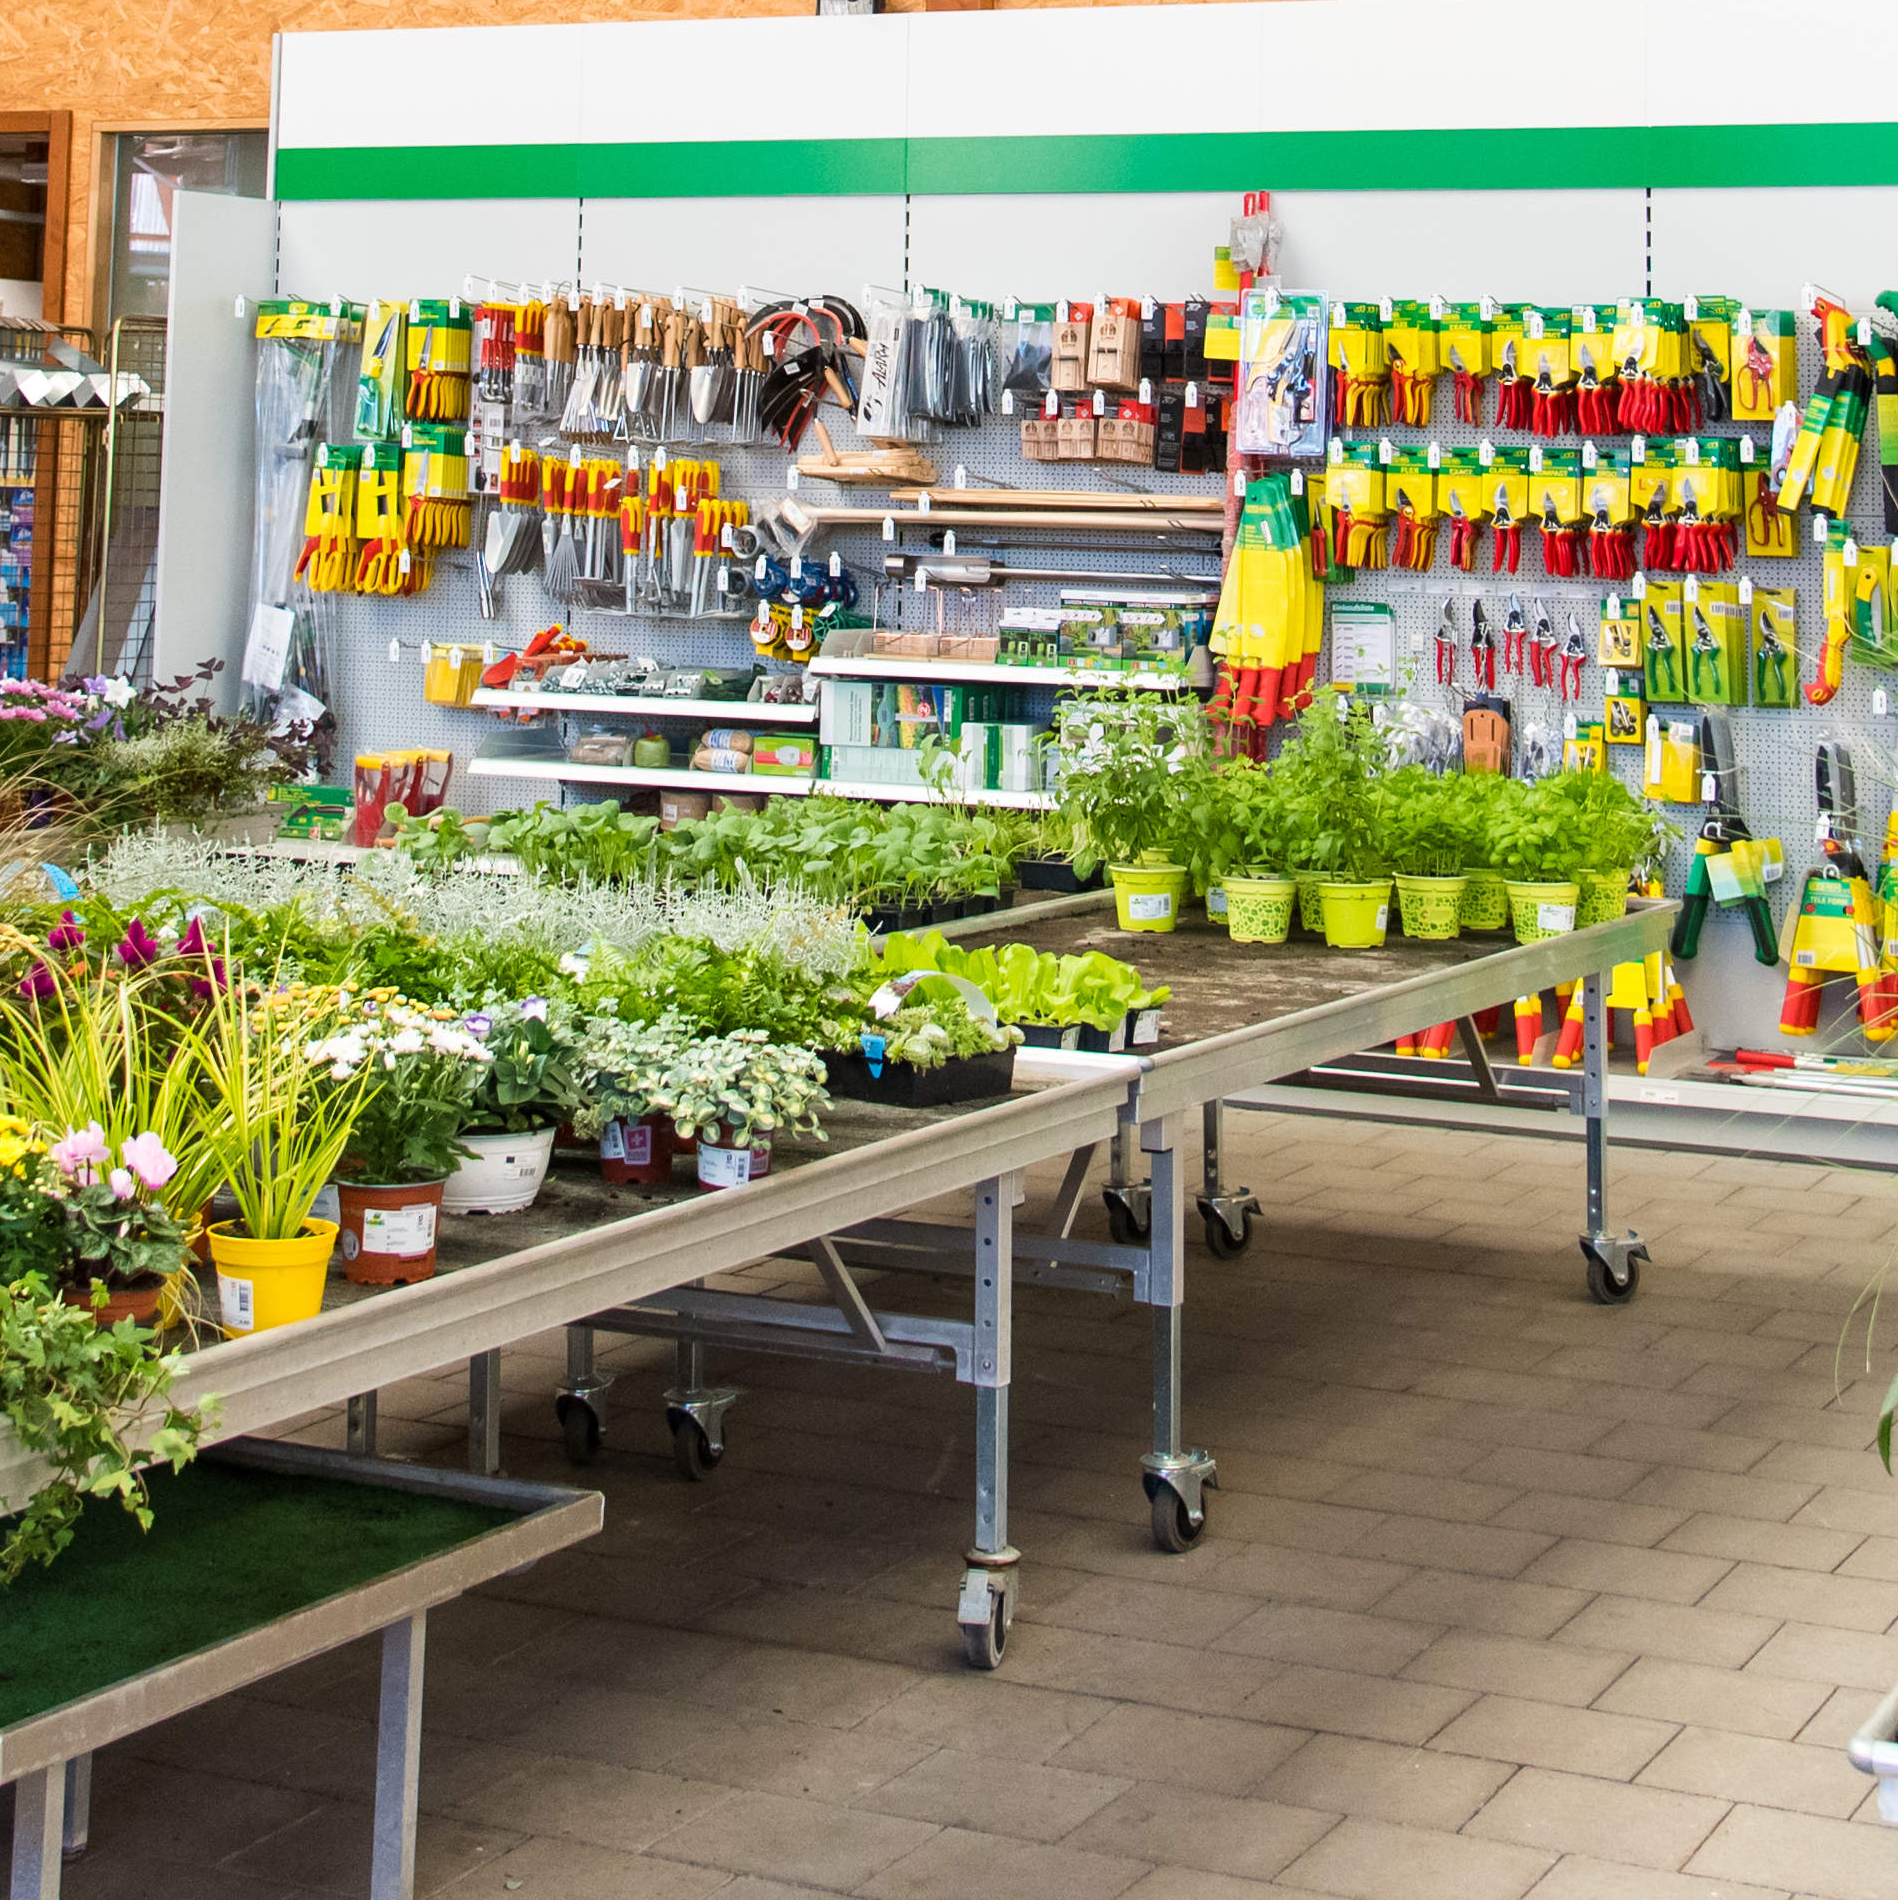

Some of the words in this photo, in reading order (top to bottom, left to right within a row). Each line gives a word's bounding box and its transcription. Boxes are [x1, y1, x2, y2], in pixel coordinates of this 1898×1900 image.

[871, 342, 891, 391] ALARM
[1401, 466, 1419, 474] FLEX
[1449, 468, 1474, 476] EXACT
[1489, 467, 1520, 475] CLASSIC
[1533, 469, 1568, 477] COMPACT
[1596, 469, 1618, 478] ERGO
[1332, 603, 1375, 612] Einkaufsliste
